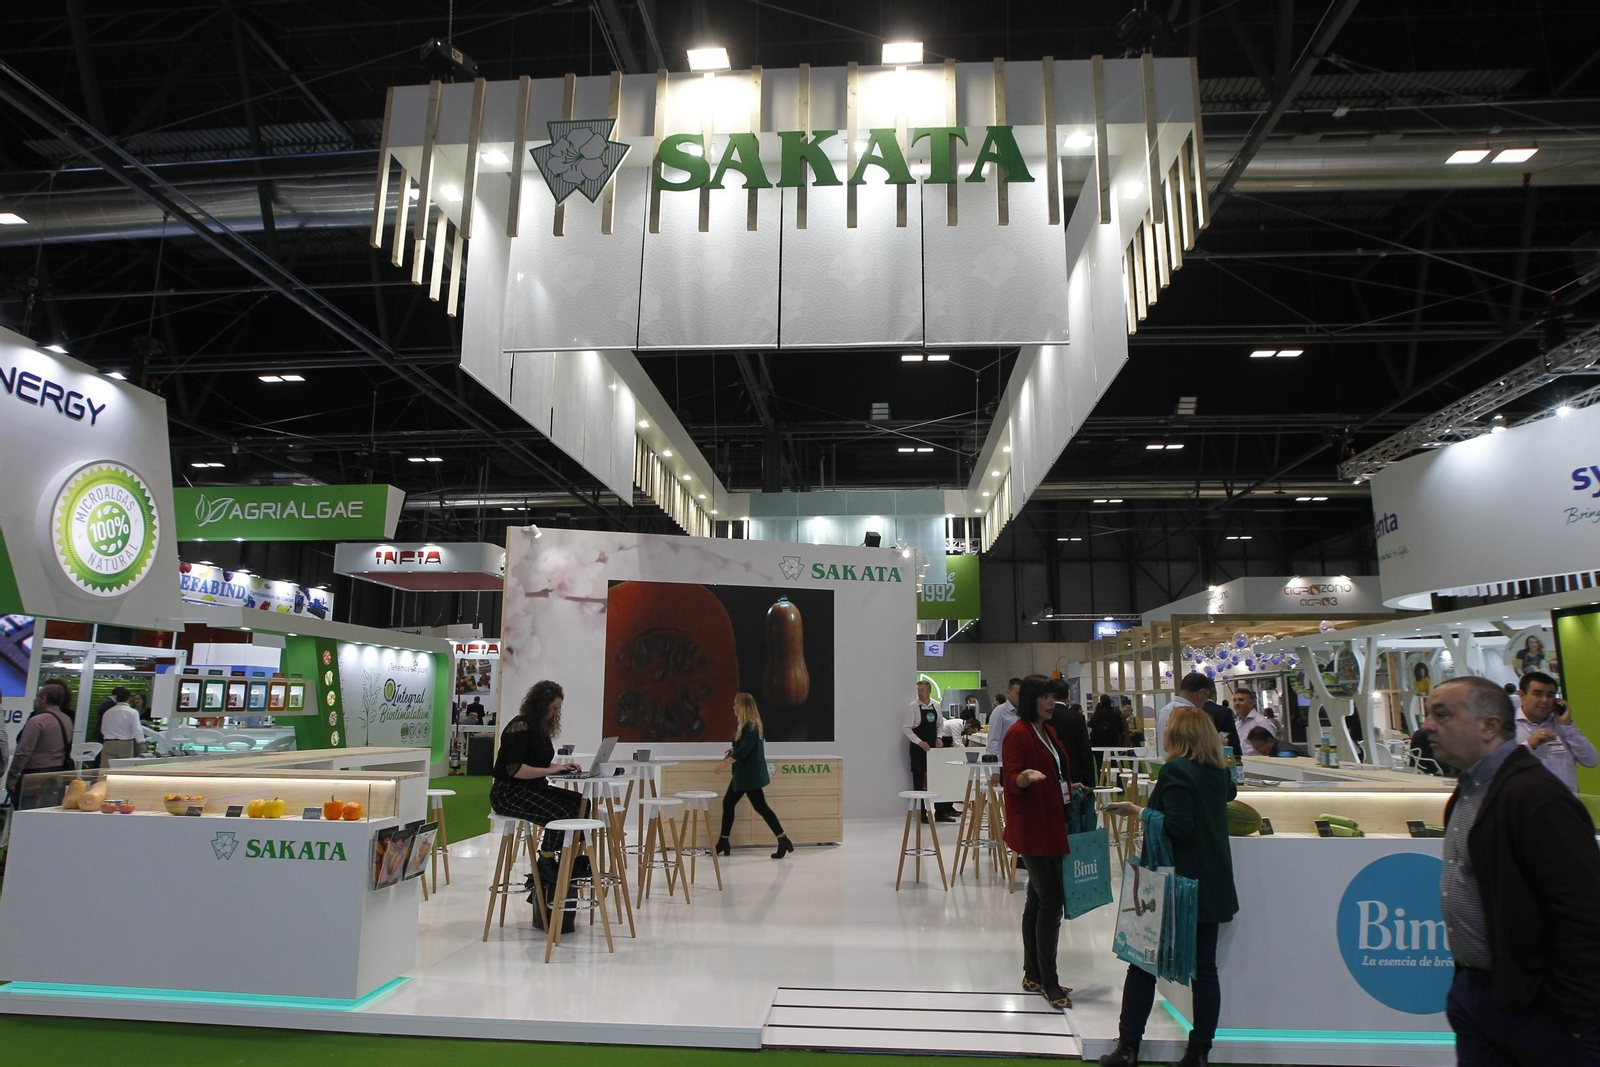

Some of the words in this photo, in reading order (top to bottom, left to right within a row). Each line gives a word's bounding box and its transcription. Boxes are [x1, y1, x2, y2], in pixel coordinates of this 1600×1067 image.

[657, 126, 1035, 191] SAKATA
[75, 487, 135, 523] MICROALGAS
[228, 501, 364, 520] AGRIALGAE
[90, 515, 130, 543] 100%
[87, 543, 139, 572] NATURAL
[811, 563, 902, 583] SAKATA
[920, 583, 956, 602] 1992
[392, 684, 426, 711] Integral
[379, 702, 430, 723] Biostimulation
[781, 764, 831, 774] SAKATA
[245, 839, 347, 861] SAKATA
[1073, 859, 1098, 878] Bimi
[1362, 956, 1376, 966] La
[1379, 956, 1417, 967] esencia
[1419, 955, 1433, 967] de
